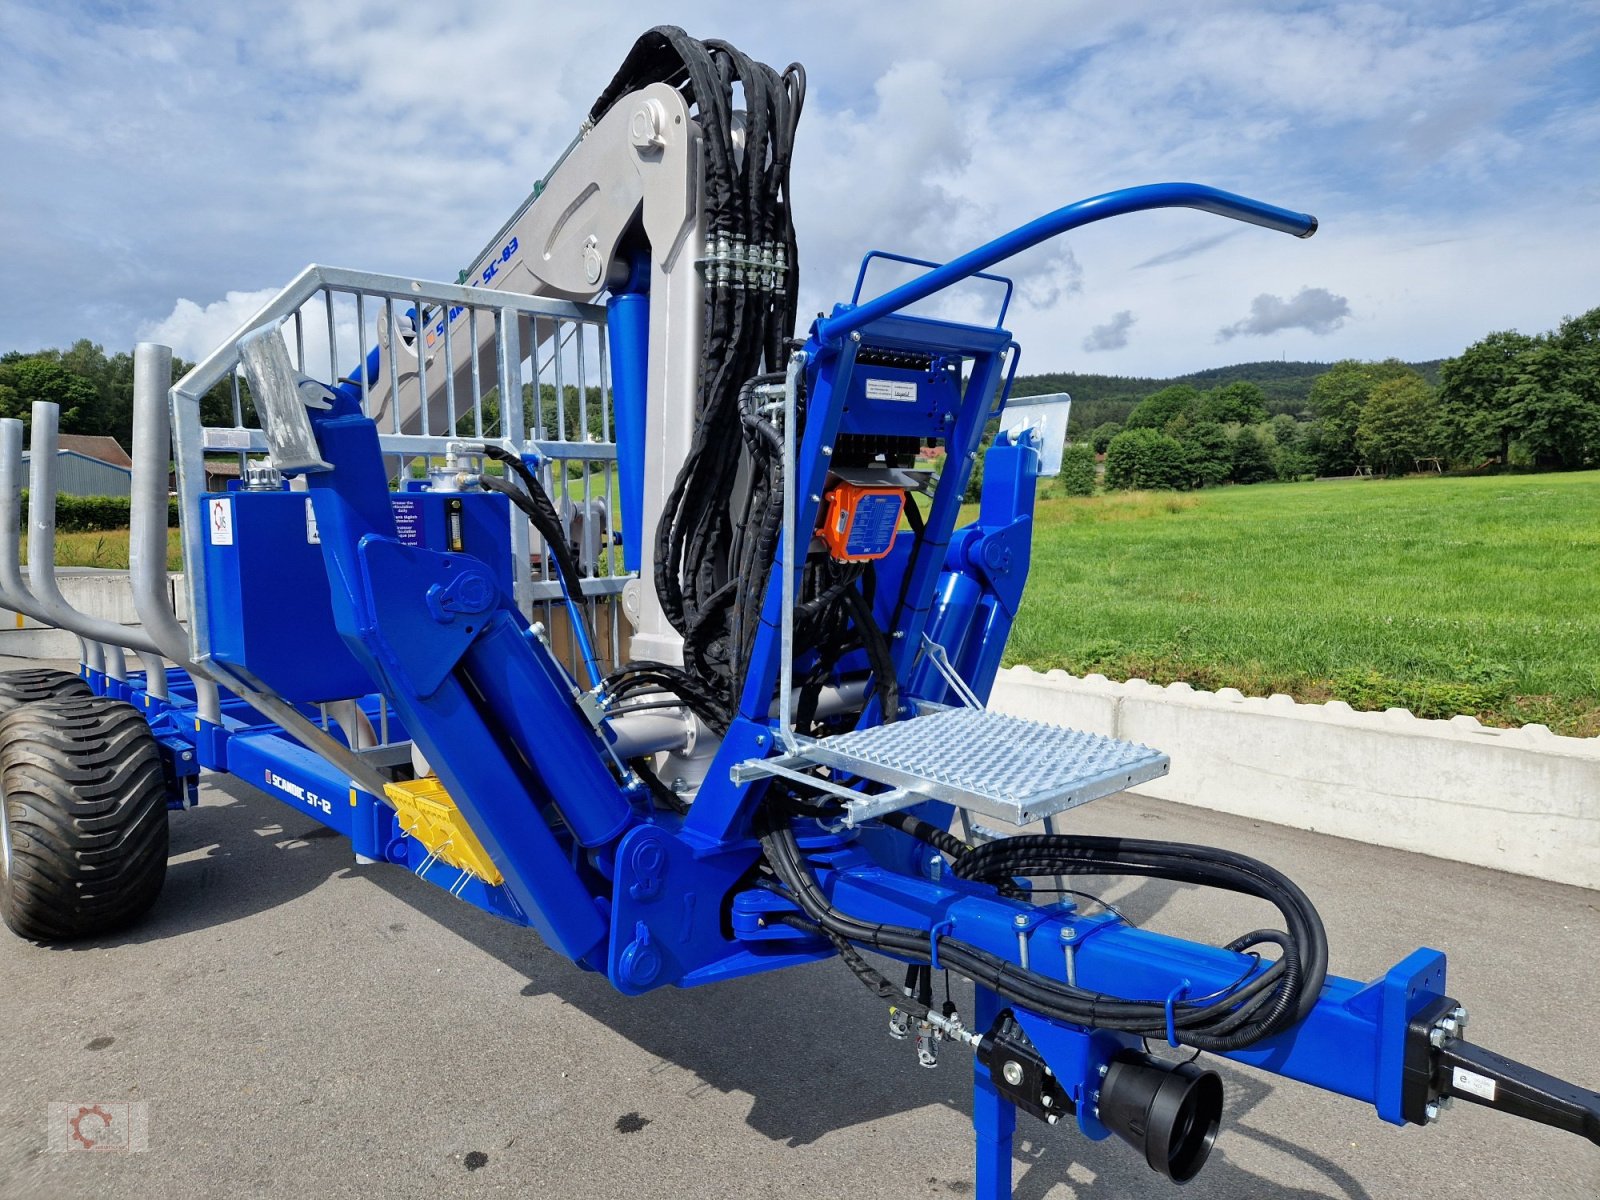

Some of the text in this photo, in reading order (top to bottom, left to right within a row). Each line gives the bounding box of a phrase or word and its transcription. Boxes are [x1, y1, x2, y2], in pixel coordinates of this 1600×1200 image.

[482, 236, 519, 285] SC-83
[272, 774, 332, 815] SCANDIC ST-12
